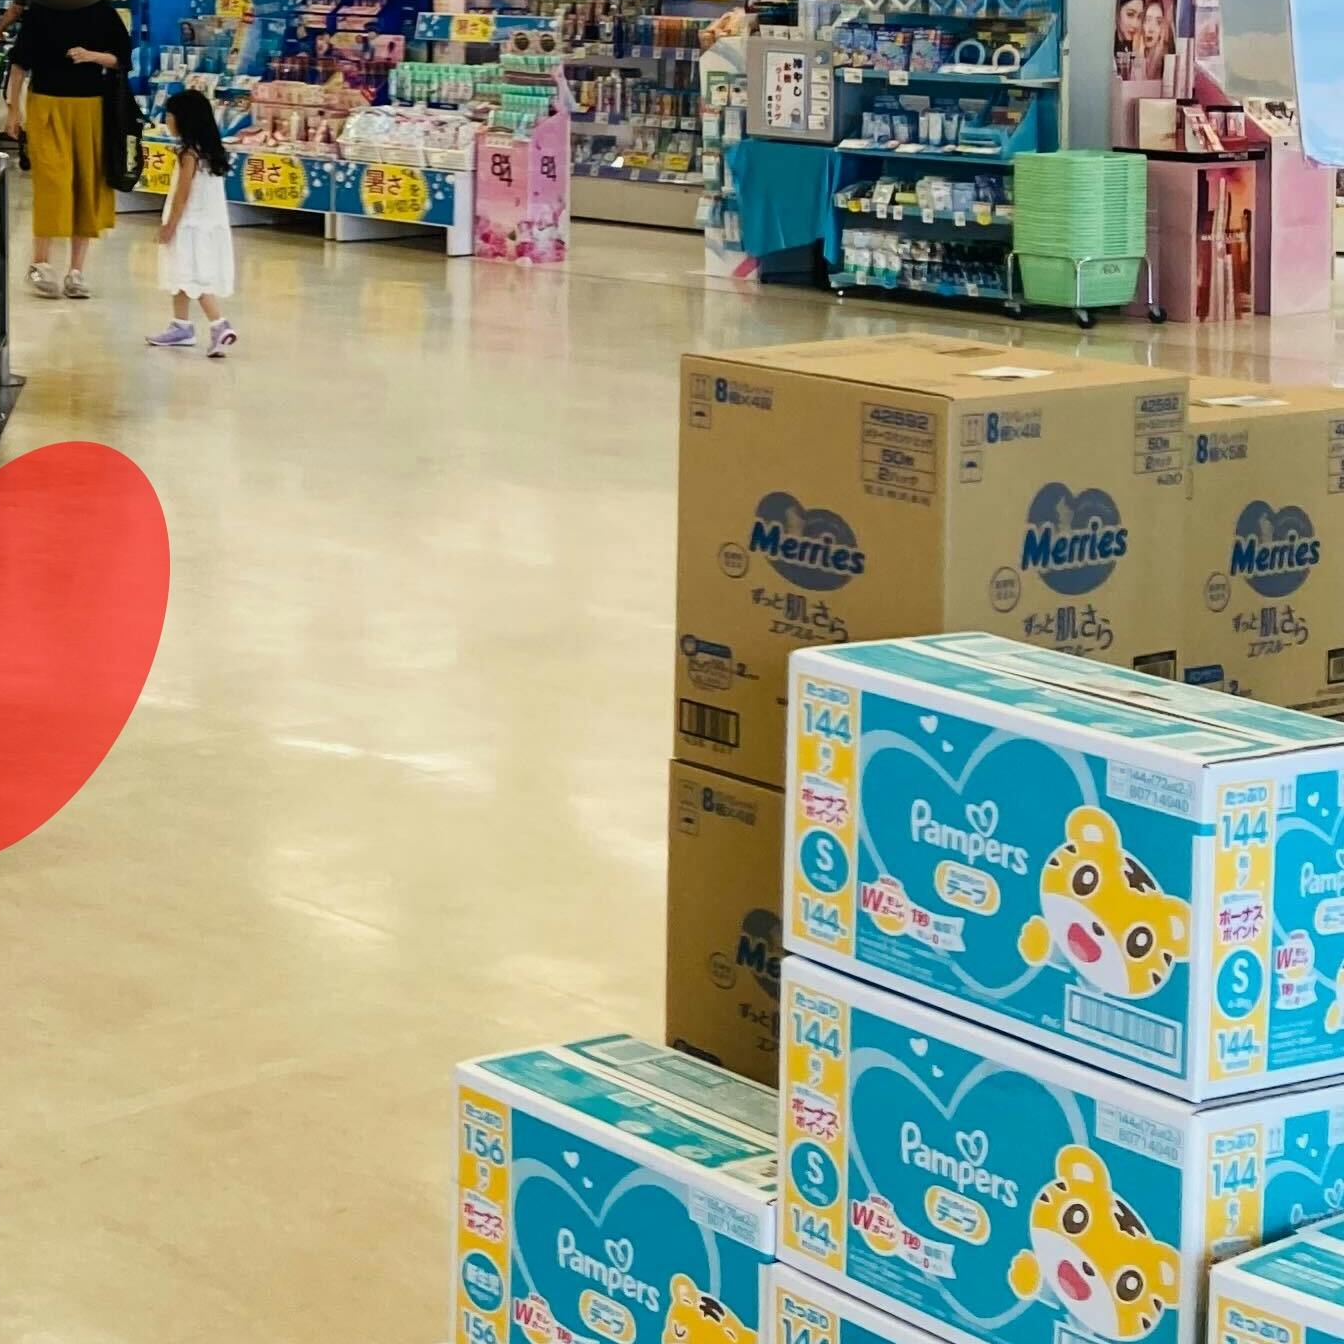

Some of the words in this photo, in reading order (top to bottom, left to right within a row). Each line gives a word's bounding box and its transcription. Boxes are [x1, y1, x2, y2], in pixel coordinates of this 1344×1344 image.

[715, 377, 728, 404] 8
[986, 412, 999, 443] 8
[1196, 435, 1208, 464] 8
[749, 522, 865, 574] Merries
[1022, 521, 1128, 571] Merries
[1230, 535, 1320, 576] Merries
[803, 704, 853, 744] 144
[912, 798, 1029, 875] Pampers
[1221, 811, 1269, 849] 144
[815, 838, 834, 871] S
[1219, 905, 1264, 925] ボーナス
[1223, 925, 1259, 942] ポイント
[1232, 958, 1250, 995] S
[793, 1013, 842, 1059] 144
[463, 1123, 505, 1165] 156
[808, 1151, 824, 1185] S
[901, 1121, 1018, 1208] Pampers
[1212, 1159, 1258, 1196] 144
[558, 1228, 660, 1312] Pampers
